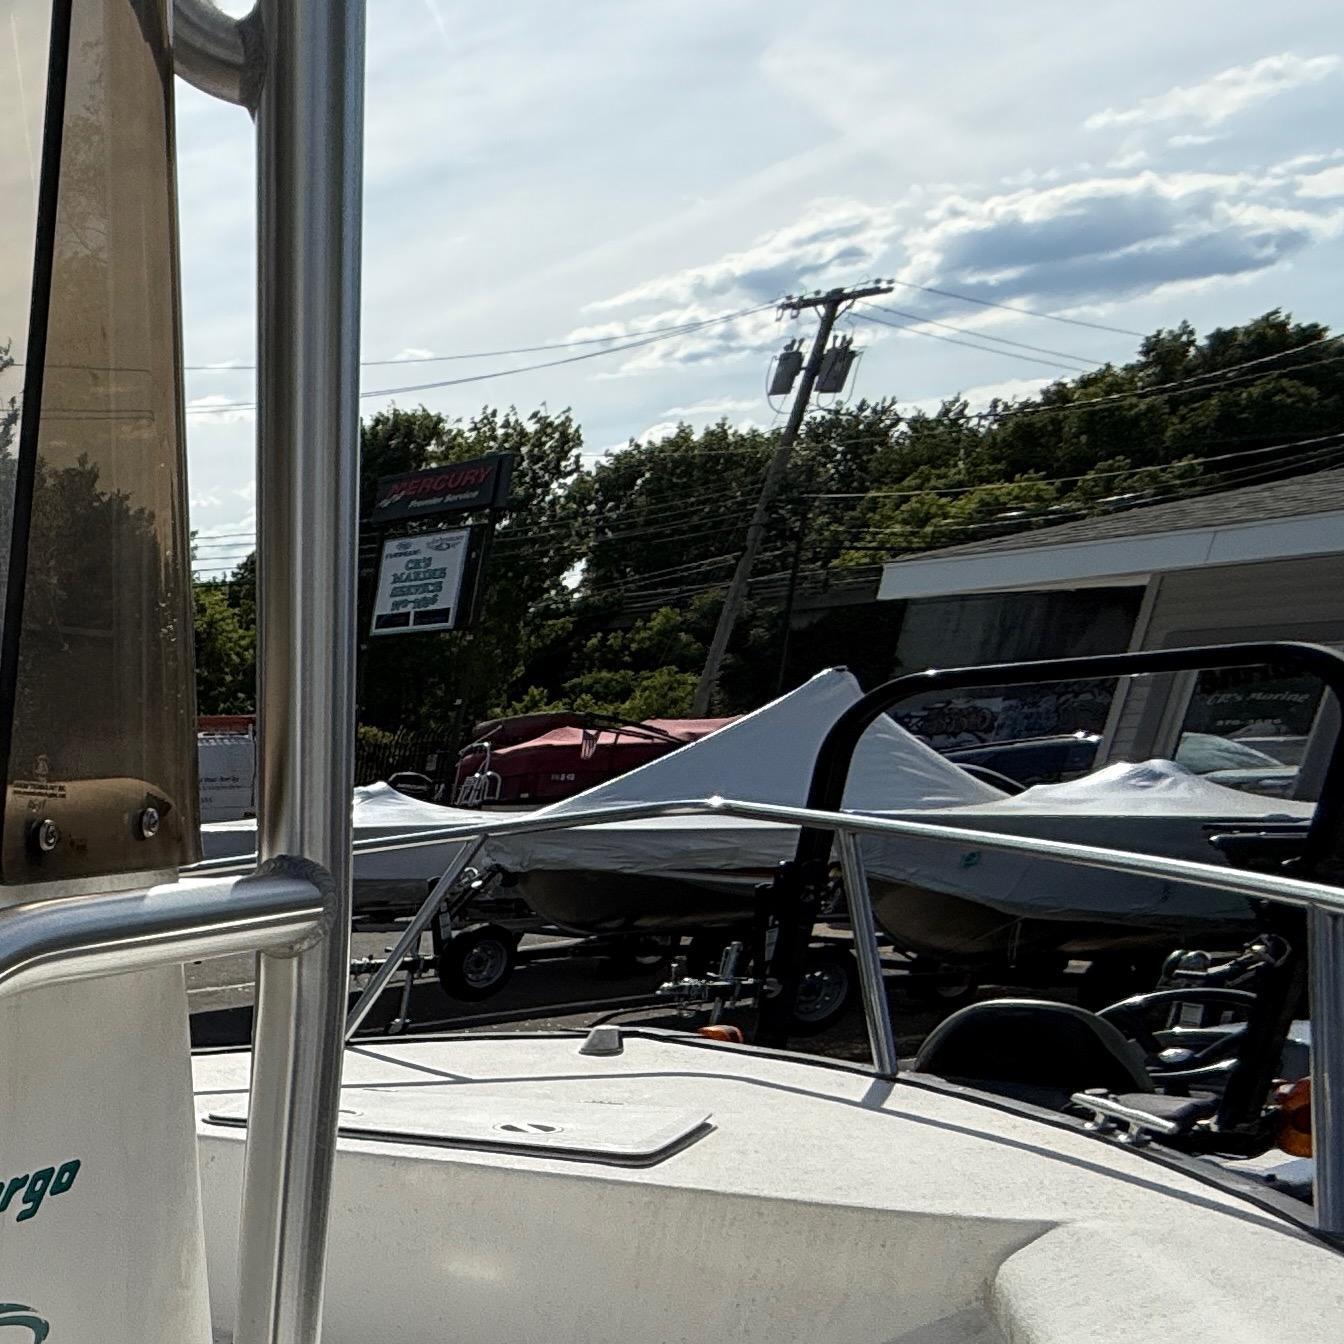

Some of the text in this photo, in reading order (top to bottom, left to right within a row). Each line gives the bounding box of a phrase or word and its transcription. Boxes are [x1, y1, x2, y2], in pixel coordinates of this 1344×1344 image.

[388, 466, 493, 497] MERCURY
[390, 567, 447, 584] MARINE
[390, 581, 443, 598] SERVICE
[1247, 691, 1310, 703] Marine
